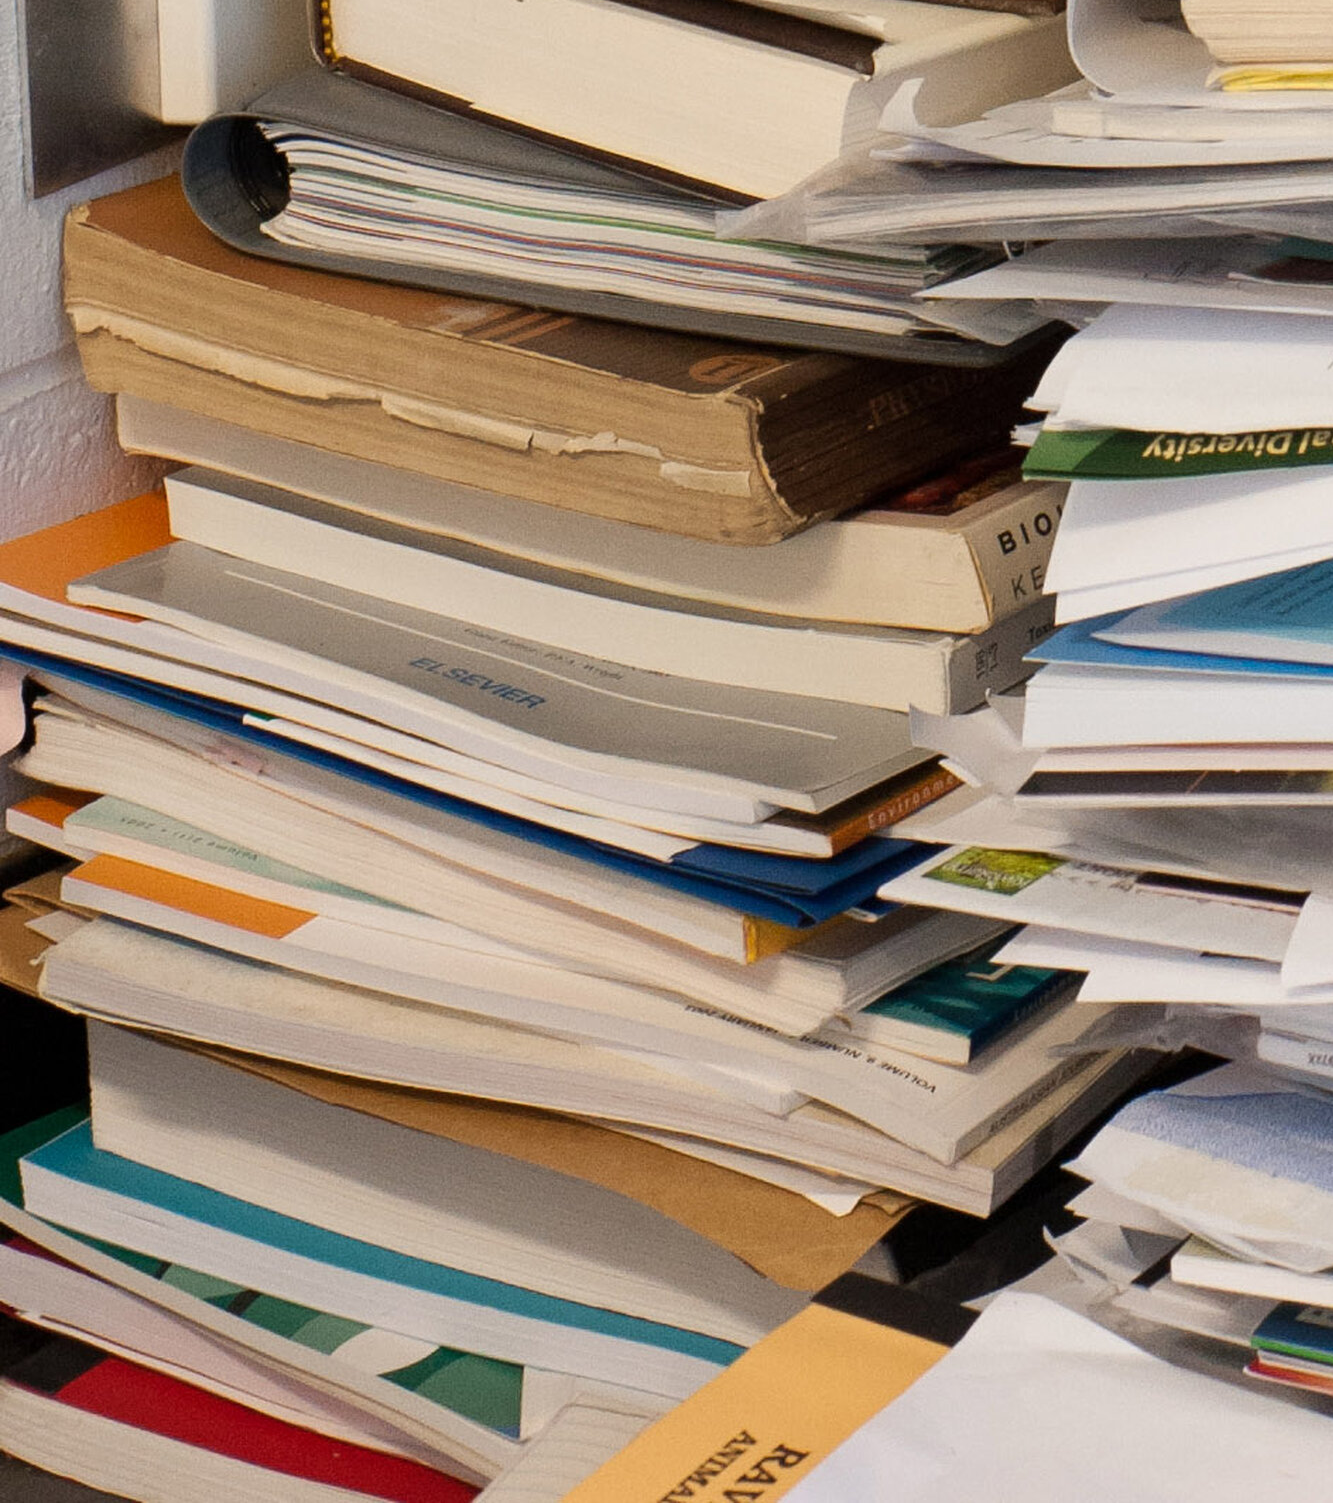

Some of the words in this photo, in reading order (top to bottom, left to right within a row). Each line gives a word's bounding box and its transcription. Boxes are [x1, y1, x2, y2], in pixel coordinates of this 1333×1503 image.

[1142, 432, 1292, 463] Diversity
[996, 503, 1064, 556] BIO
[409, 655, 548, 711] ELSEVIER
[656, 1428, 758, 1503] ANIMA
[727, 1439, 811, 1503] RAV
